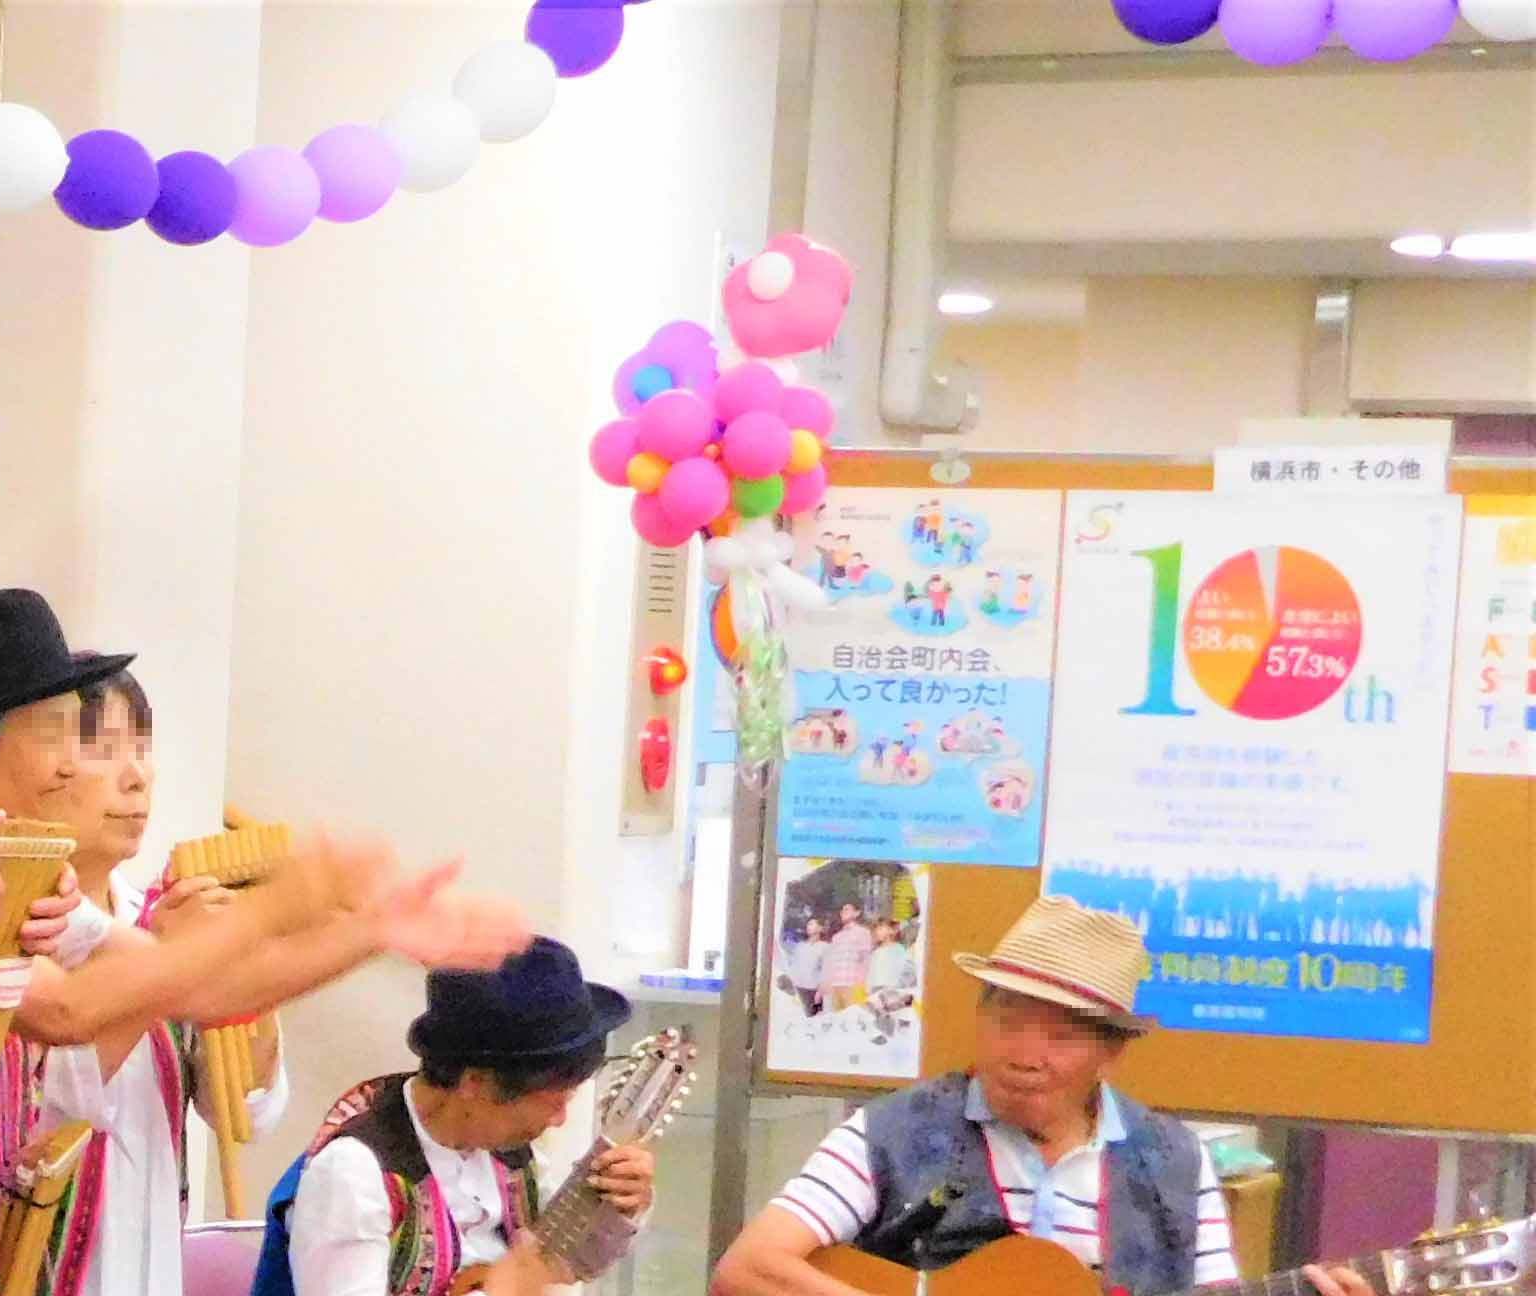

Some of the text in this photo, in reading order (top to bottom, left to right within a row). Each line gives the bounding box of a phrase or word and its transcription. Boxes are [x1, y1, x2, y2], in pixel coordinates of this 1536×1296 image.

[1250, 458, 1422, 481] 横浜市・その他
